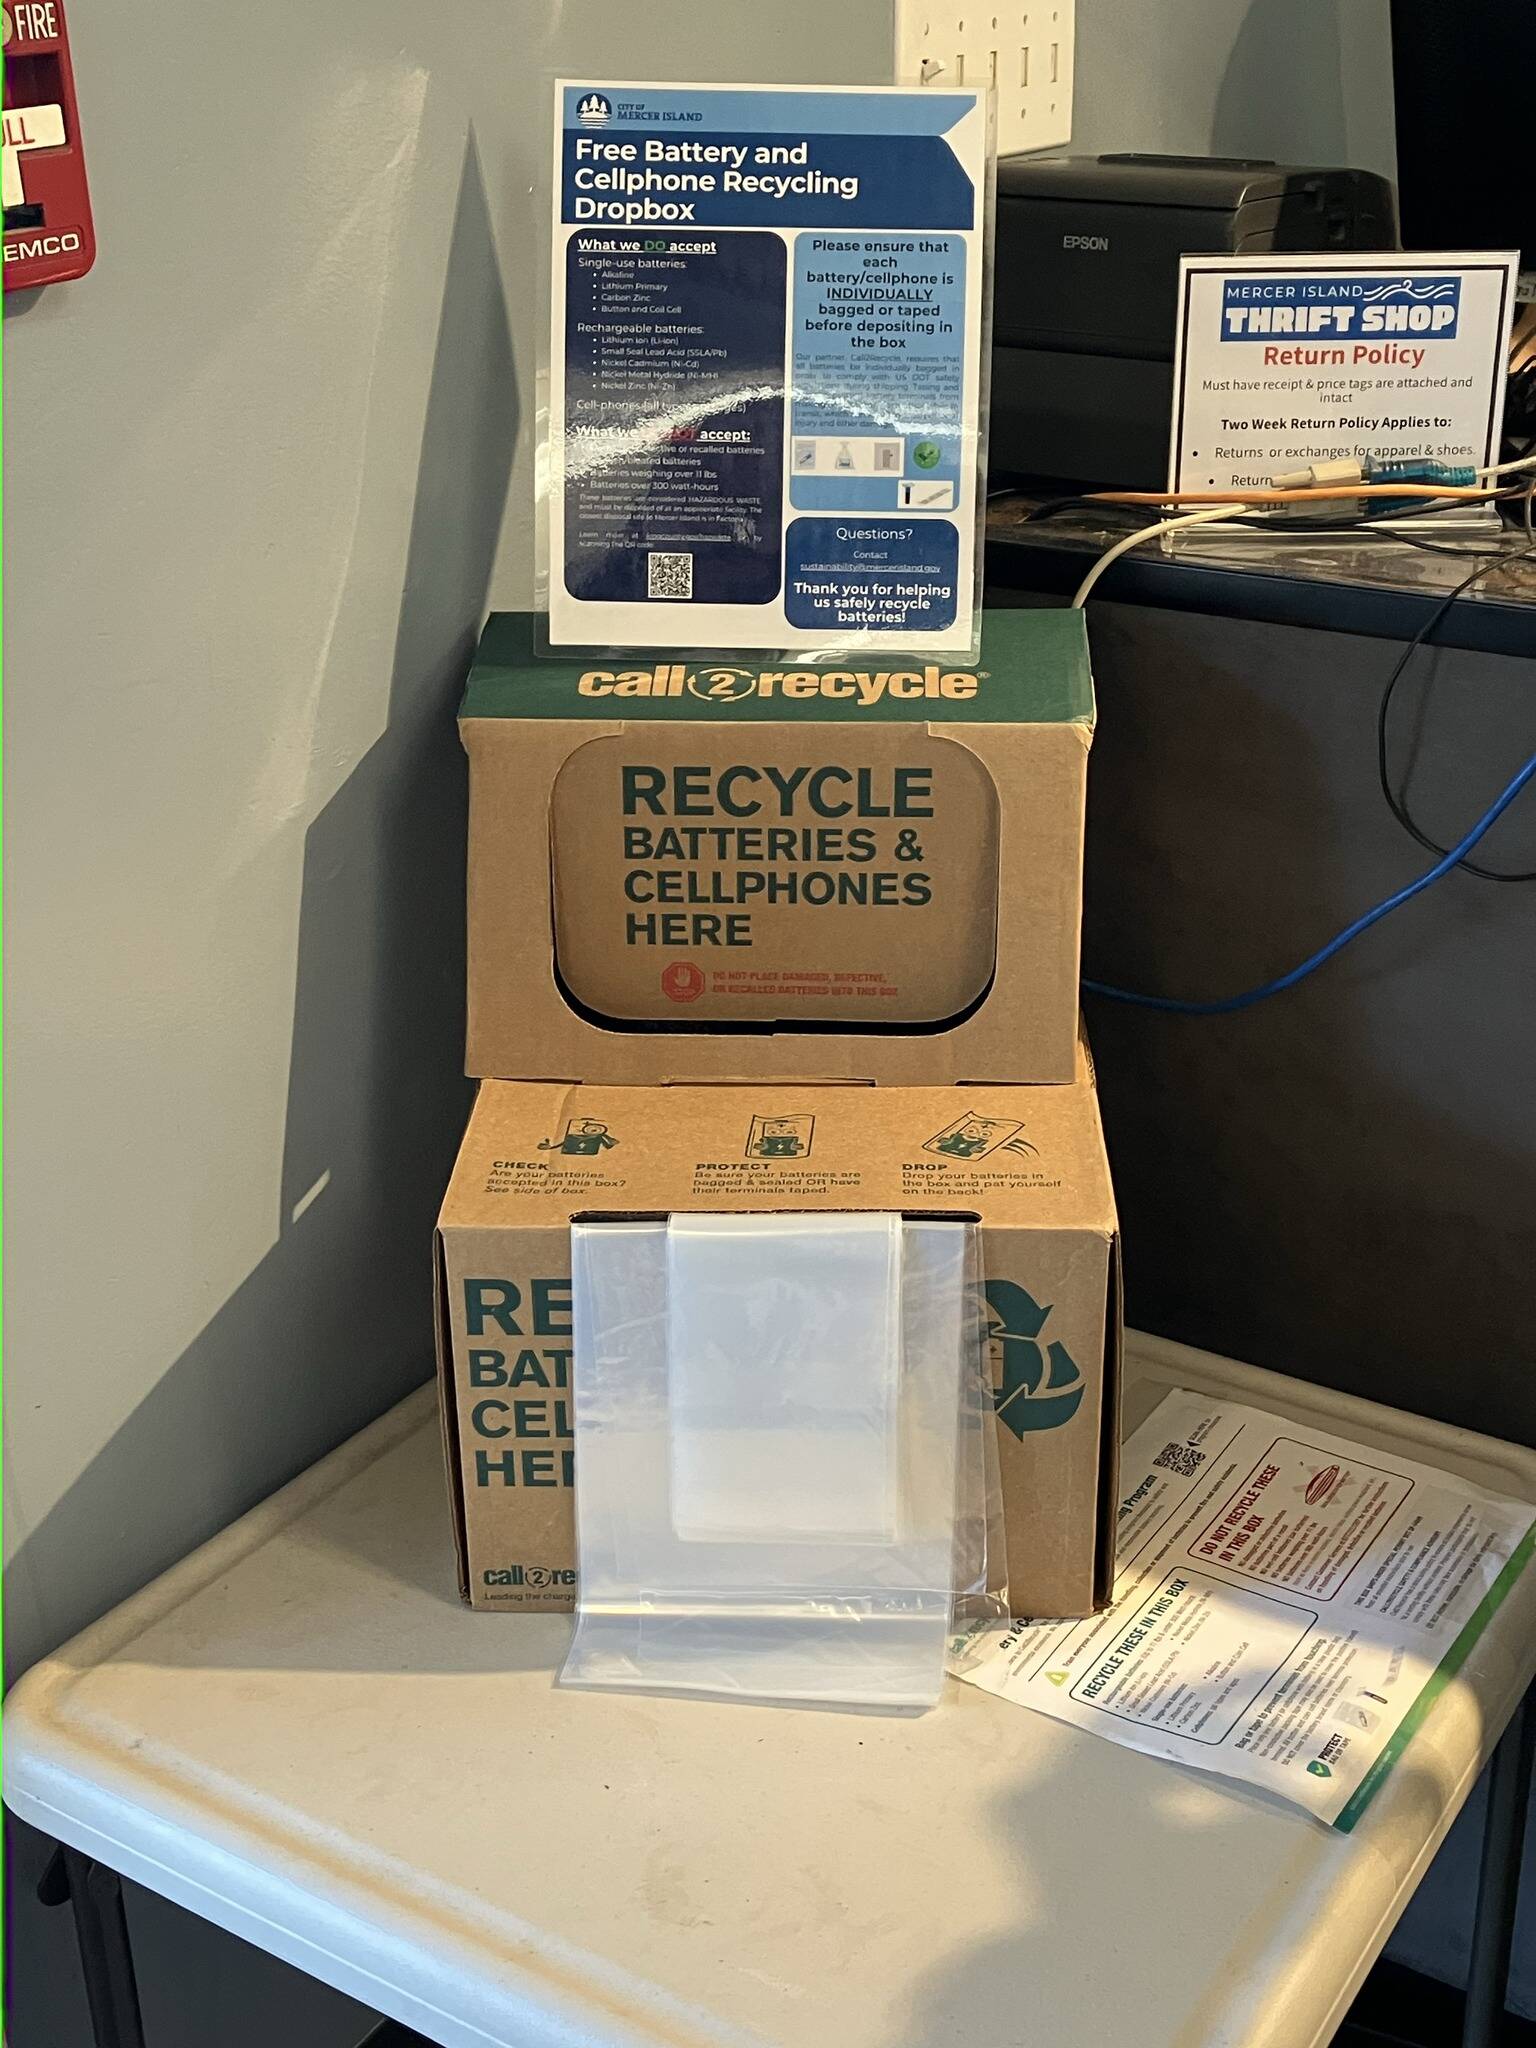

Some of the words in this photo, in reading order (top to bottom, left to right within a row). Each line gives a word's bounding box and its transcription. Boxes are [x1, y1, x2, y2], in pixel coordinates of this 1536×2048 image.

[14, 2, 58, 40] FIRE
[617, 111, 660, 121] MERCER
[662, 112, 703, 121] ISLAND
[576, 139, 637, 160] Free
[645, 141, 748, 168] Battery
[755, 142, 808, 164] and
[575, 168, 716, 195] Cellphone
[723, 171, 858, 199] Recycling
[575, 197, 695, 224] Dropbox
[578, 239, 616, 251] What
[620, 242, 640, 251] we
[644, 241, 666, 251] DO
[669, 241, 717, 254] accept
[813, 240, 860, 252] Please
[864, 242, 914, 252] ensure
[919, 241, 949, 253] that
[1063, 235, 1109, 251] EPSON
[578, 258, 635, 269] Single-use
[638, 259, 688, 269] batteries:
[863, 257, 898, 268] each
[807, 271, 938, 286] battery/cellphone
[942, 272, 954, 285] is
[601, 282, 634, 290] Lithium
[635, 283, 668, 292] Primary
[827, 288, 933, 301] INDIVIDUALLY
[1227, 286, 1295, 299] MERCER
[1302, 285, 1364, 298] ISLAND
[601, 294, 631, 302] Carbon
[633, 294, 651, 302] Zinc
[818, 303, 874, 318] bagged
[878, 306, 894, 316] or
[898, 305, 940, 318] taped
[1225, 306, 1355, 333] THRIFT
[1361, 304, 1456, 332] SHOP
[577, 323, 652, 335] Rechargeable
[655, 324, 704, 335] batteries:
[806, 319, 852, 331] before
[857, 320, 935, 335] depositing
[939, 321, 953, 333] in
[851, 337, 875, 348] the
[879, 337, 906, 348] box
[1264, 346, 1345, 366] Return
[1353, 344, 1425, 369] Policy
[1202, 380, 1230, 390] Must
[1233, 379, 1261, 390] have
[1263, 379, 1303, 392] receipt
[1305, 379, 1314, 389] &
[1317, 379, 1346, 392] price
[1349, 379, 1373, 391] tags
[1375, 379, 1394, 389] are
[1396, 377, 1448, 389] attached
[1450, 376, 1473, 388] and
[1320, 392, 1353, 403] intact
[1221, 419, 1249, 430] Two
[1252, 418, 1287, 430] Week
[1291, 418, 1335, 429] Return
[1339, 417, 1379, 431] Policy
[1381, 416, 1431, 430] Applies
[1434, 417, 1452, 427] to:
[576, 425, 614, 438] What
[617, 429, 638, 438] we
[700, 430, 751, 443] accept:
[689, 446, 724, 454] recalled
[726, 446, 765, 455] batteries
[1215, 447, 1263, 458] Returns
[1269, 448, 1282, 458] or
[1285, 446, 1351, 460] exchanges
[1354, 444, 1371, 456] for
[1374, 444, 1421, 458] apparel
[1424, 444, 1434, 455] &
[1437, 444, 1476, 456] shoes.
[662, 457, 701, 466] batteries
[631, 470, 673, 480] weighing
[704, 471, 718, 479] lbs
[590, 481, 630, 489] Batteries
[652, 482, 669, 490] 300
[670, 482, 719, 491] watt-hours
[836, 527, 913, 540] Questions?
[853, 551, 888, 559] Contact
[794, 582, 838, 595] Thank
[842, 585, 868, 597] you
[872, 584, 893, 596] for
[897, 584, 951, 599] helping
[814, 598, 830, 608] us
[834, 597, 875, 611] safely
[879, 599, 931, 613] recycle
[838, 611, 906, 623] batteries!
[621, 766, 934, 818] RECYCLE
[624, 827, 876, 862] BATTERIES
[894, 829, 926, 862] &
[623, 871, 932, 906] CELLPHONES
[626, 913, 753, 947] HERE
[492, 1160, 550, 1170] CHECK
[695, 1163, 771, 1171] PROTECT
[902, 1163, 948, 1171] DROP
[489, 1169, 512, 1177] Are
[516, 1171, 544, 1179] your
[548, 1171, 605, 1179] batteries
[902, 1172, 934, 1181] Drop
[938, 1173, 966, 1181] your
[970, 1172, 1028, 1180] batteries
[484, 1185, 509, 1193] See
[513, 1186, 541, 1194] side
[544, 1186, 559, 1194] of
[487, 1178, 548, 1187] accepted
[551, 1178, 563, 1186] in
[567, 1178, 591, 1187] this
[595, 1179, 627, 1187] box?
[693, 1178, 742, 1187] bagged
[830, 1178, 861, 1186] have
[984, 1181, 1004, 1189] pat
[1009, 1180, 1062, 1189] yourself
[725, 1186, 785, 1194] terminals
[790, 1187, 830, 1195] taped.
[464, 1278, 572, 1336] RE
[468, 1349, 573, 1388] BAT
[475, 1450, 574, 1487] HE
[1122, 1473, 1162, 1508] Program
[1198, 1540, 1219, 1555] DO
[1209, 1524, 1233, 1542] NOT
[1221, 1488, 1262, 1526] RECYCLE
[1249, 1463, 1282, 1491] THESE
[1240, 1513, 1265, 1533] BOX
[1225, 1531, 1252, 1552] THIS
[1216, 1549, 1236, 1562] IN
[1163, 1577, 1190, 1597] BOX
[484, 1593, 523, 1601] Leading
[1146, 1595, 1174, 1618] THIS
[1138, 1615, 1157, 1629] IN
[1114, 1627, 1149, 1657] THESE
[1079, 1655, 1126, 1698] RECYCLE
[1316, 1732, 1344, 1761] PROTECT
